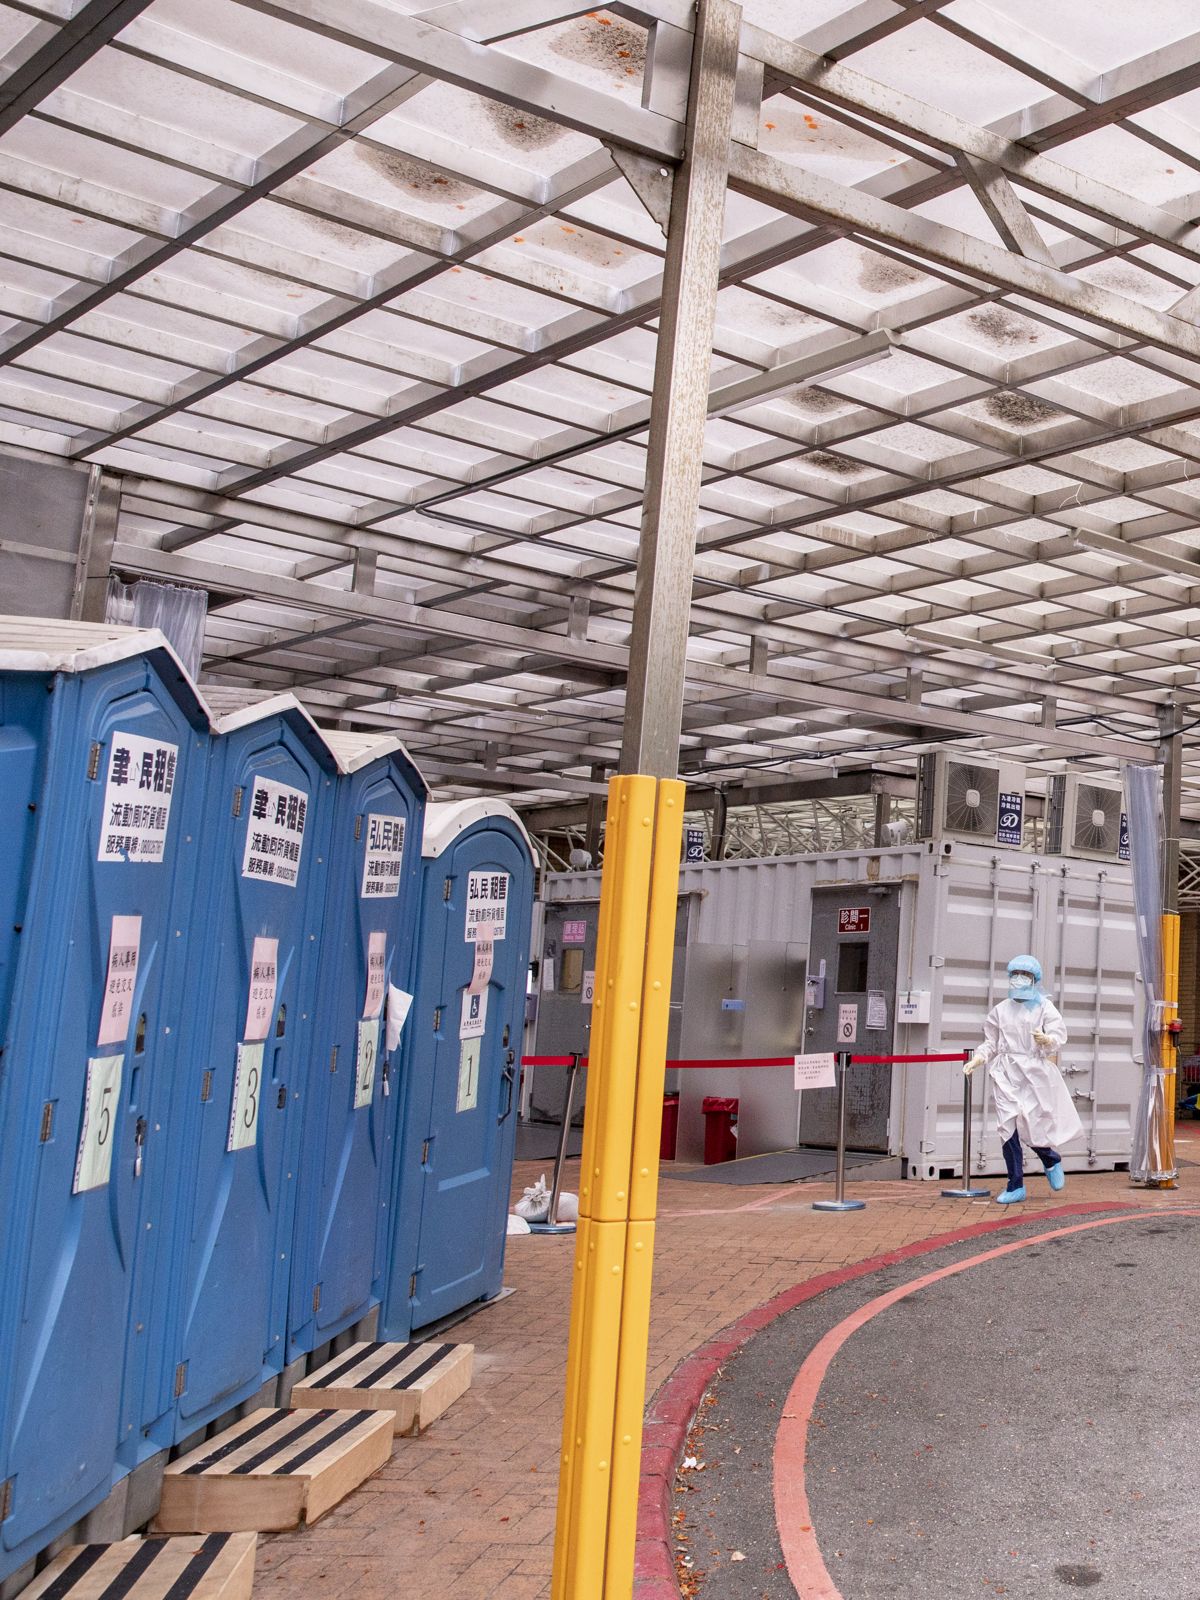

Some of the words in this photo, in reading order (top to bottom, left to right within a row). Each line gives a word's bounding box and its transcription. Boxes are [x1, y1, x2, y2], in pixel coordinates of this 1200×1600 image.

[469, 876, 507, 900] 弘民租售
[840, 910, 868, 924] 診間一
[362, 1040, 372, 1090] 2
[466, 1055, 472, 1097] 1
[98, 1087, 112, 1145] 5
[244, 1067, 258, 1128] 3
